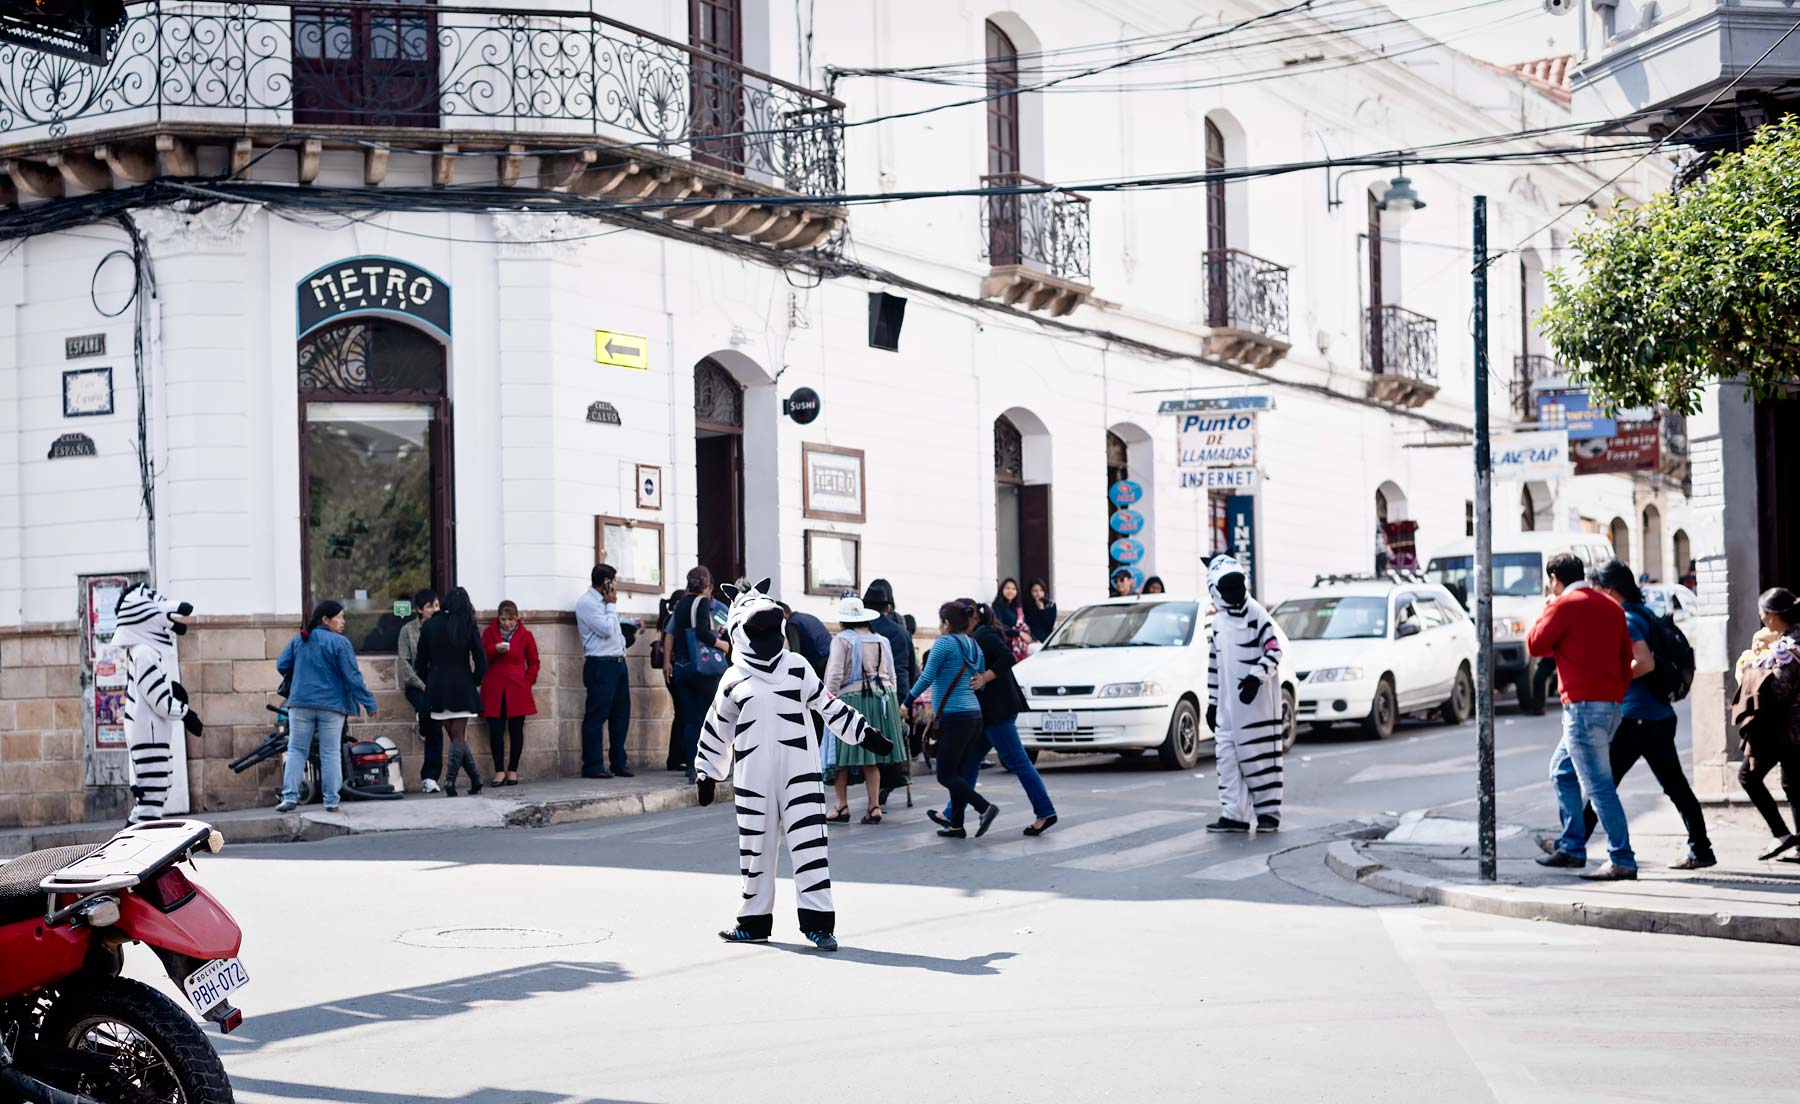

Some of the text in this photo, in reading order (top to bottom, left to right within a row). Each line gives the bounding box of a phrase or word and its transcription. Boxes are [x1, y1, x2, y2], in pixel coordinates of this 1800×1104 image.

[310, 266, 433, 309] METRO
[591, 411, 617, 423] CALVO
[1183, 413, 1251, 433] Punto
[1206, 434, 1223, 446] DE
[54, 442, 90, 457] ESPAÑA
[1182, 447, 1252, 463] LLAMADAS
[815, 468, 855, 494] METRO
[1181, 471, 1252, 488] INTERNET
[196, 960, 225, 983] BOLIVIA
[192, 963, 246, 1010] PBH-072
